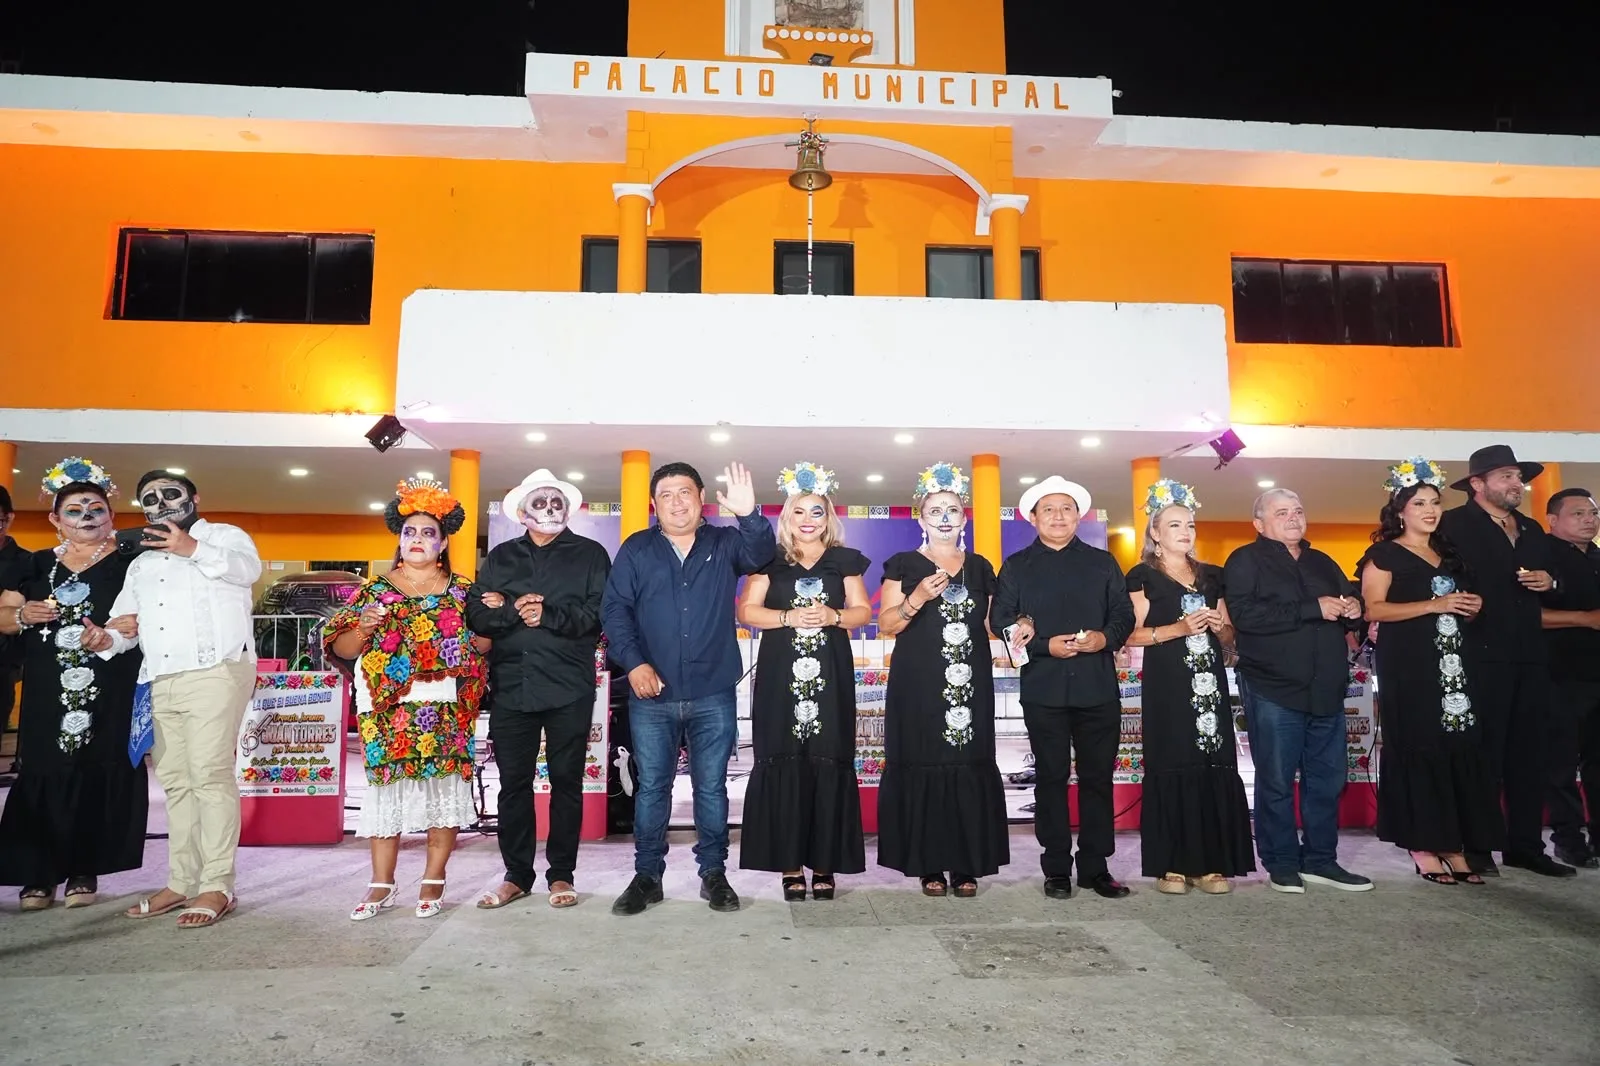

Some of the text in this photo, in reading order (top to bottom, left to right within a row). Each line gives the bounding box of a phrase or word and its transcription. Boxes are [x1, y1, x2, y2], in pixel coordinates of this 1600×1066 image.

[573, 60, 1069, 111] PALACIO MUNICIPAL
[308, 692, 332, 704] BONITO
[293, 724, 336, 744] TORRES
[1346, 717, 1370, 735] RRES
[585, 784, 603, 792] Spotify
